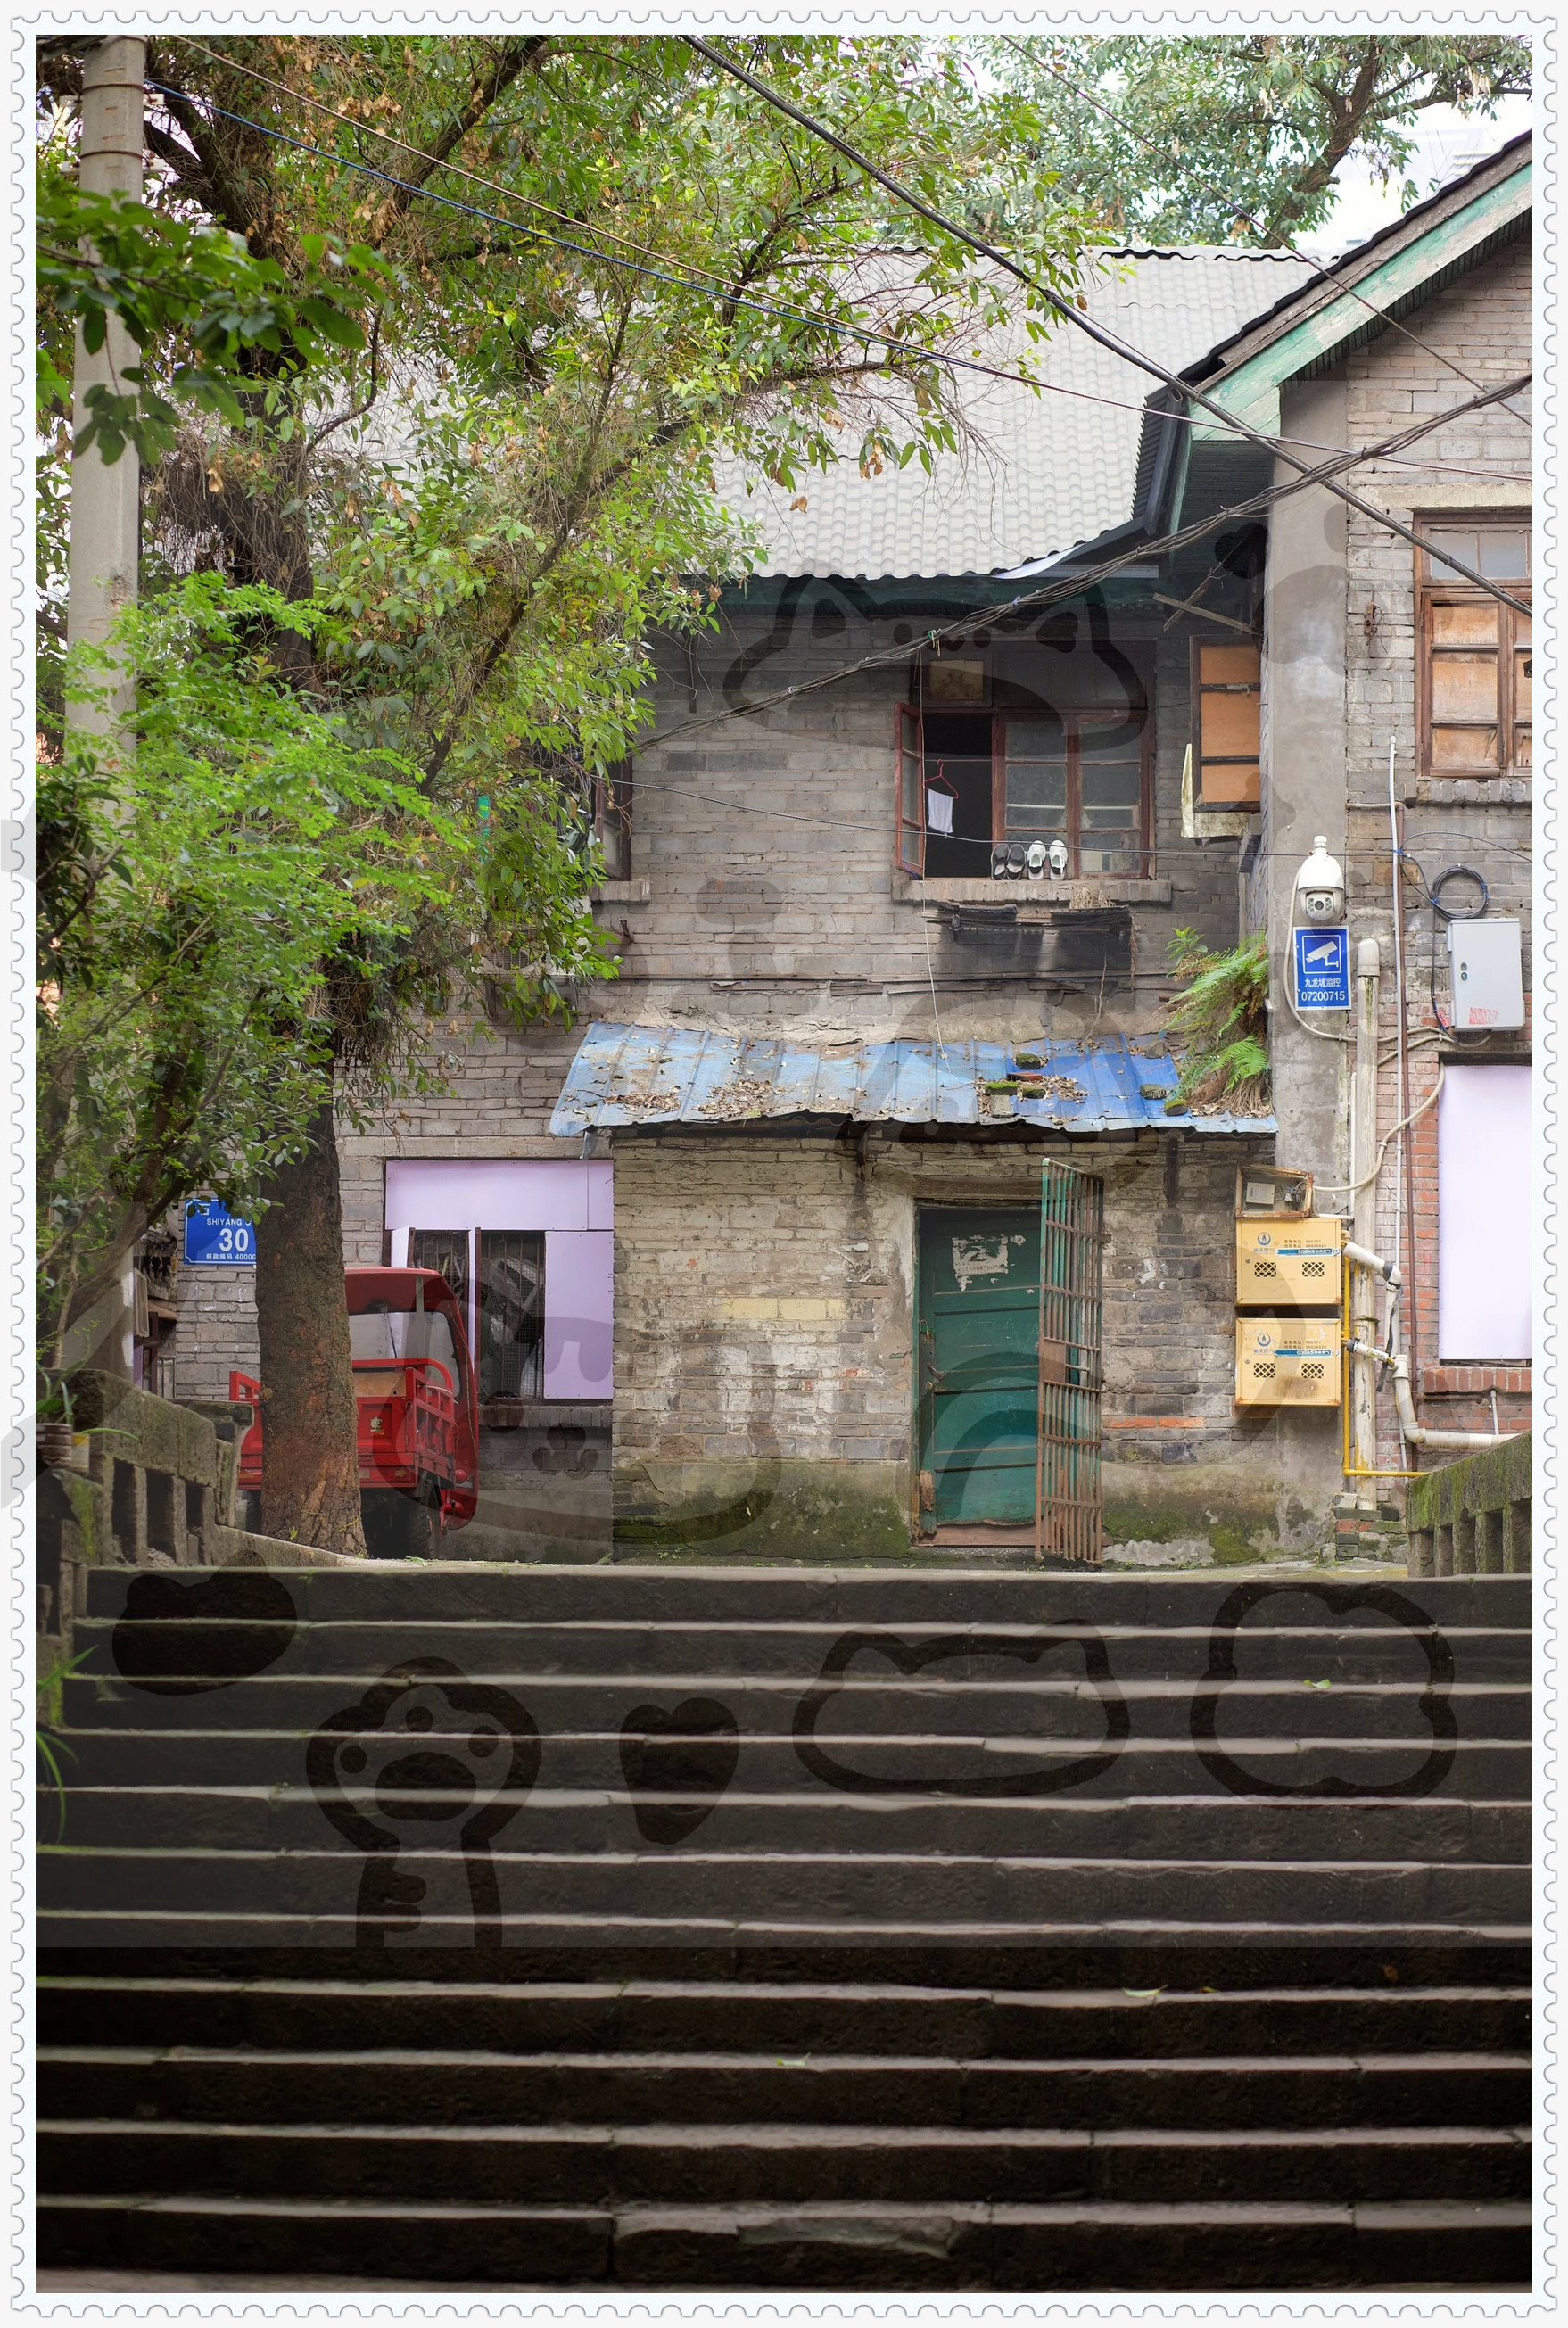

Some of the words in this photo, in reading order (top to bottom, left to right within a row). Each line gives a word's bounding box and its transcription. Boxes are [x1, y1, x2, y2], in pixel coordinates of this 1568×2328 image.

[1304, 978, 1341, 988] 九龙坡监控
[1300, 990, 1346, 1002] 07200715
[206, 1218, 243, 1226] SHIYANG
[219, 1227, 249, 1252] 30
